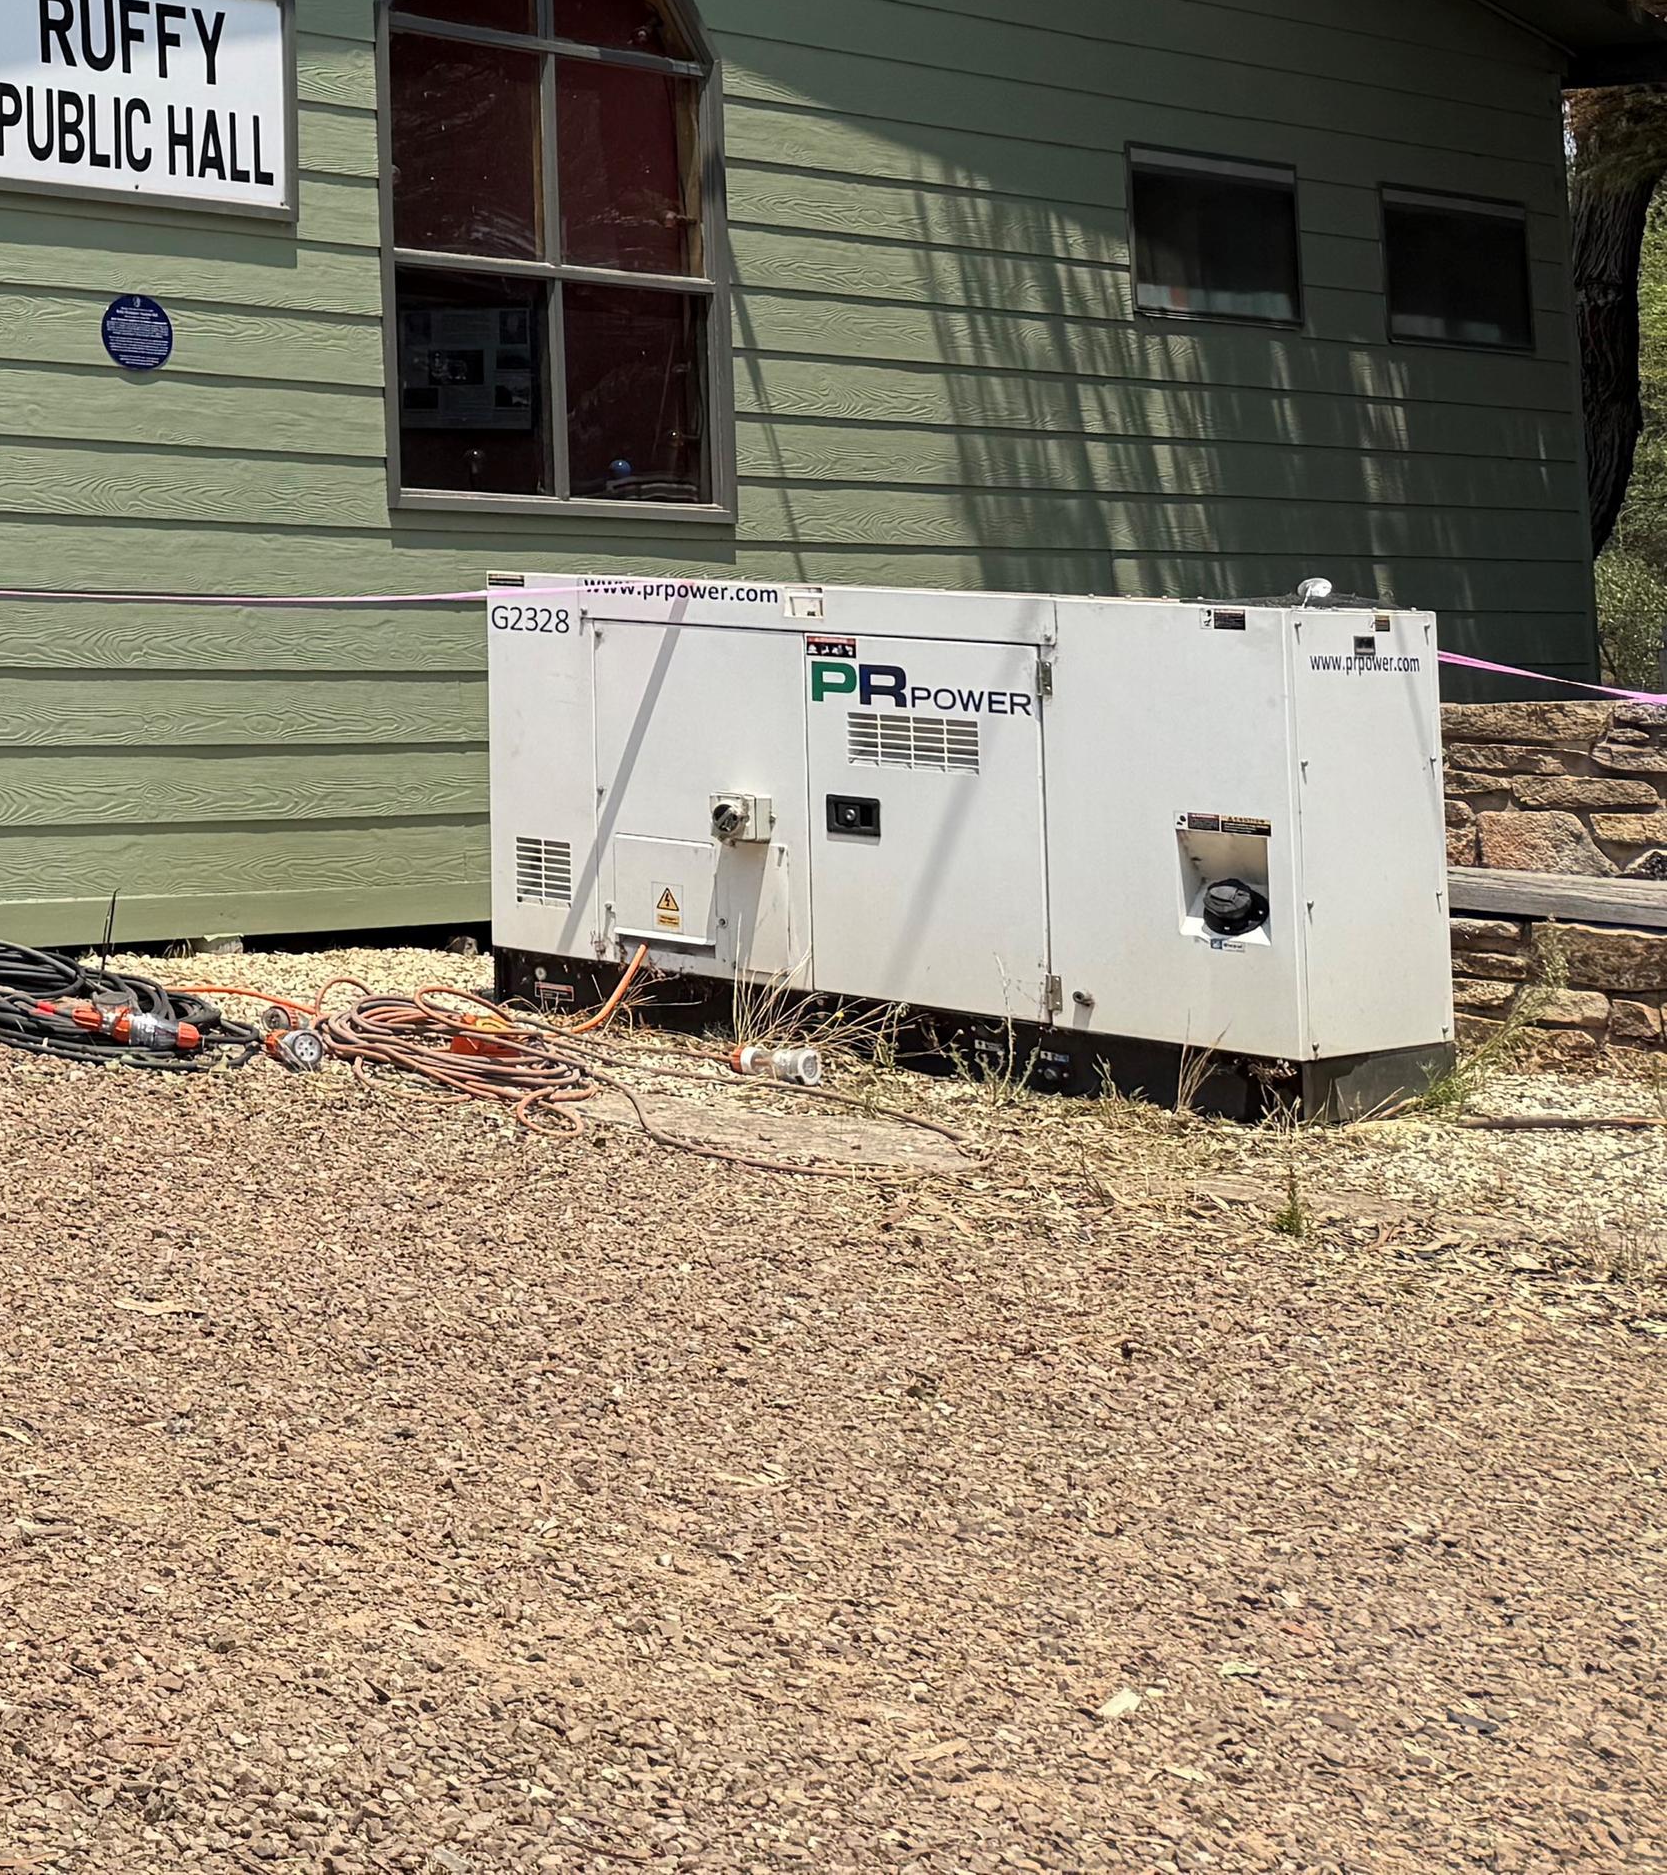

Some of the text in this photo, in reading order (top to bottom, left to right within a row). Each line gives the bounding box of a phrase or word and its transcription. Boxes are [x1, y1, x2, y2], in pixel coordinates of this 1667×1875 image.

[167, 104, 274, 187] HALL
[491, 604, 571, 634] G2328
[1309, 653, 1421, 676] www.prpower.com
[911, 686, 1033, 717] POWER
